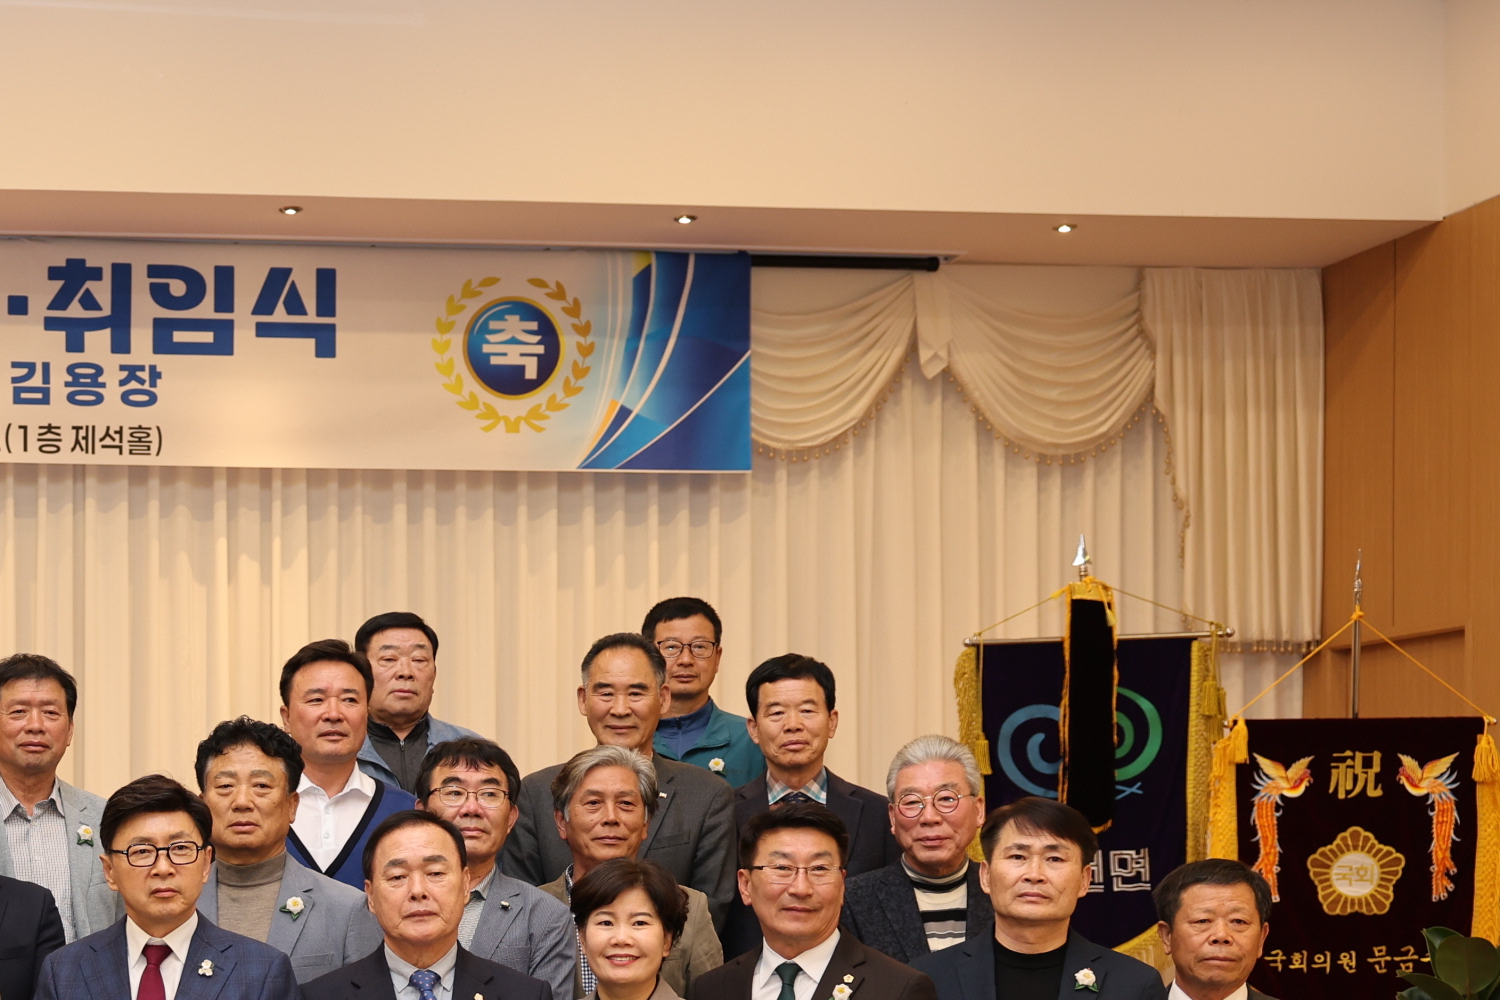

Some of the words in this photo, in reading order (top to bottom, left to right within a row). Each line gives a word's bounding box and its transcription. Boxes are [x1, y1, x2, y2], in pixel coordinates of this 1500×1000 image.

[482, 314, 546, 380] 축
[1329, 750, 1384, 799] 祝
[1334, 863, 1375, 887] 국회
[1264, 949, 1357, 974] 국회의원
